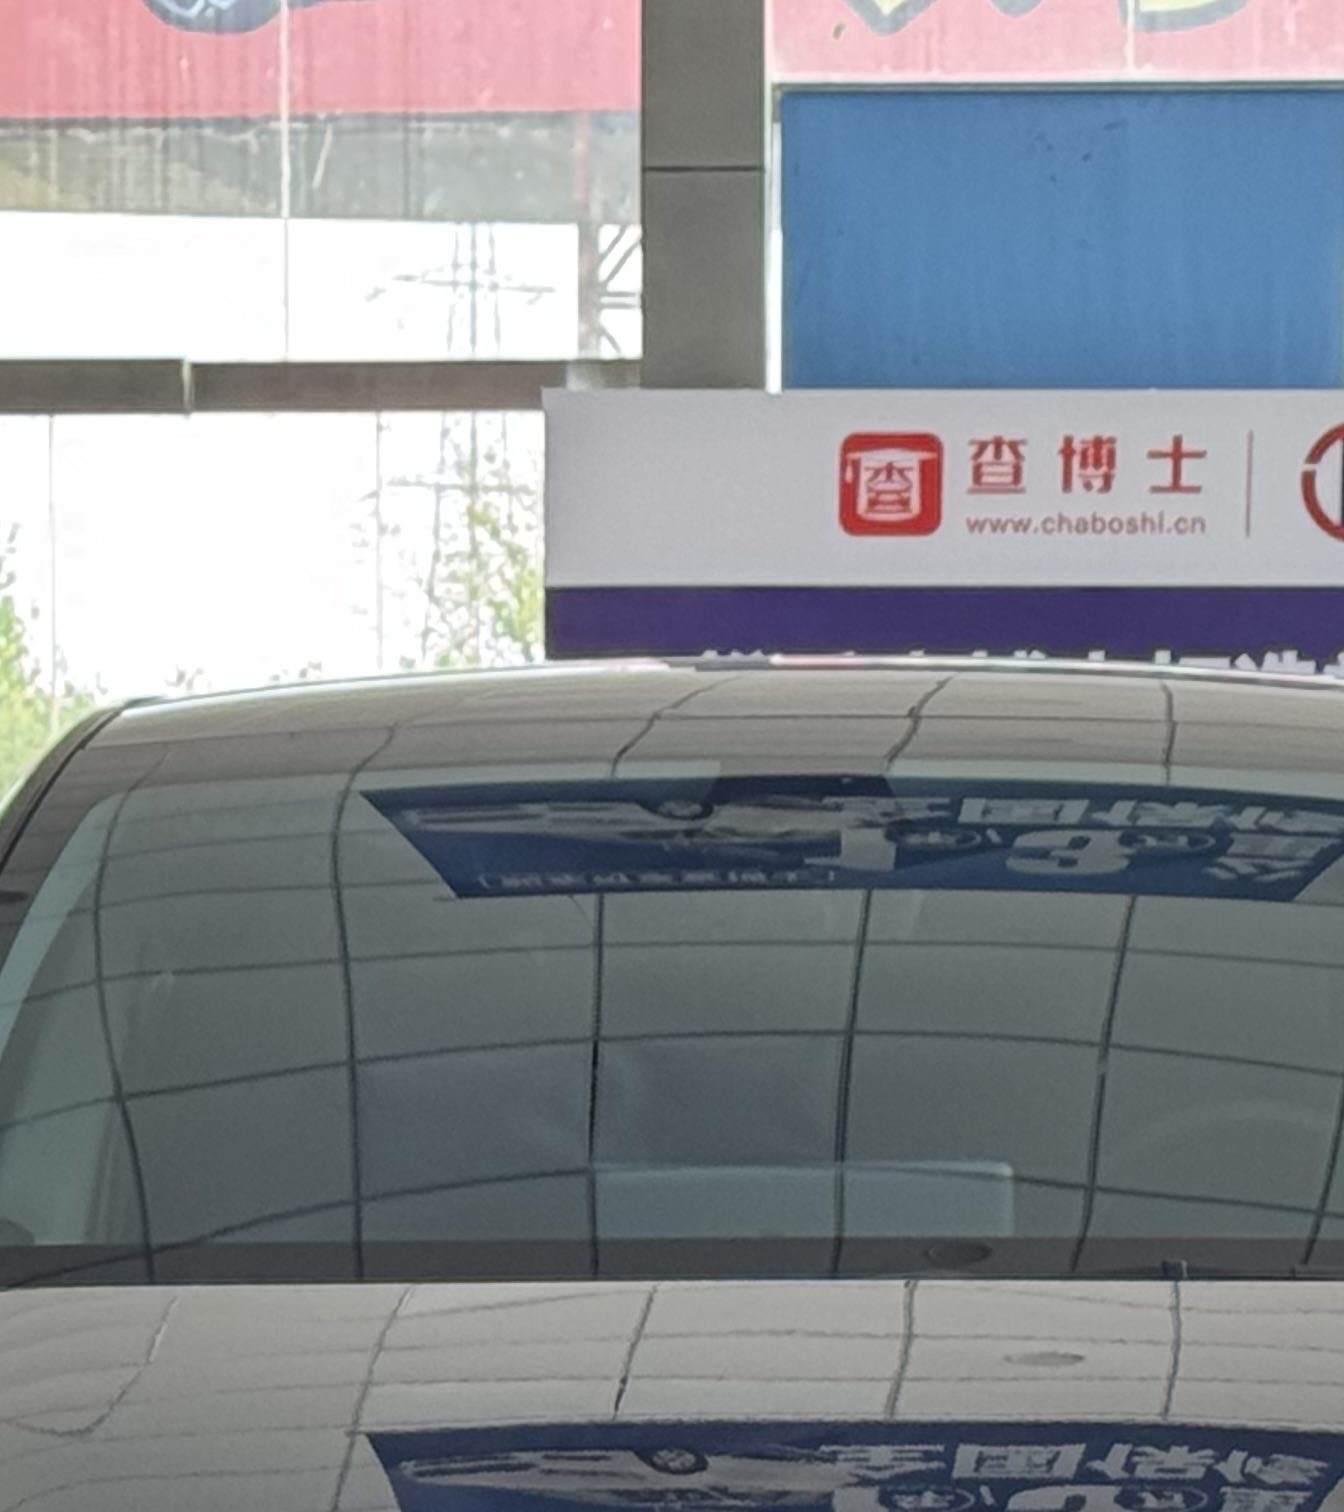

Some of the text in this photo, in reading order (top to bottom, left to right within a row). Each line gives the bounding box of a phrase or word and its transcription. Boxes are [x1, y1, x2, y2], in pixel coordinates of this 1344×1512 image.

[966, 434, 1208, 495] 查博士
[965, 511, 1207, 536] www.chaboshi.cn
